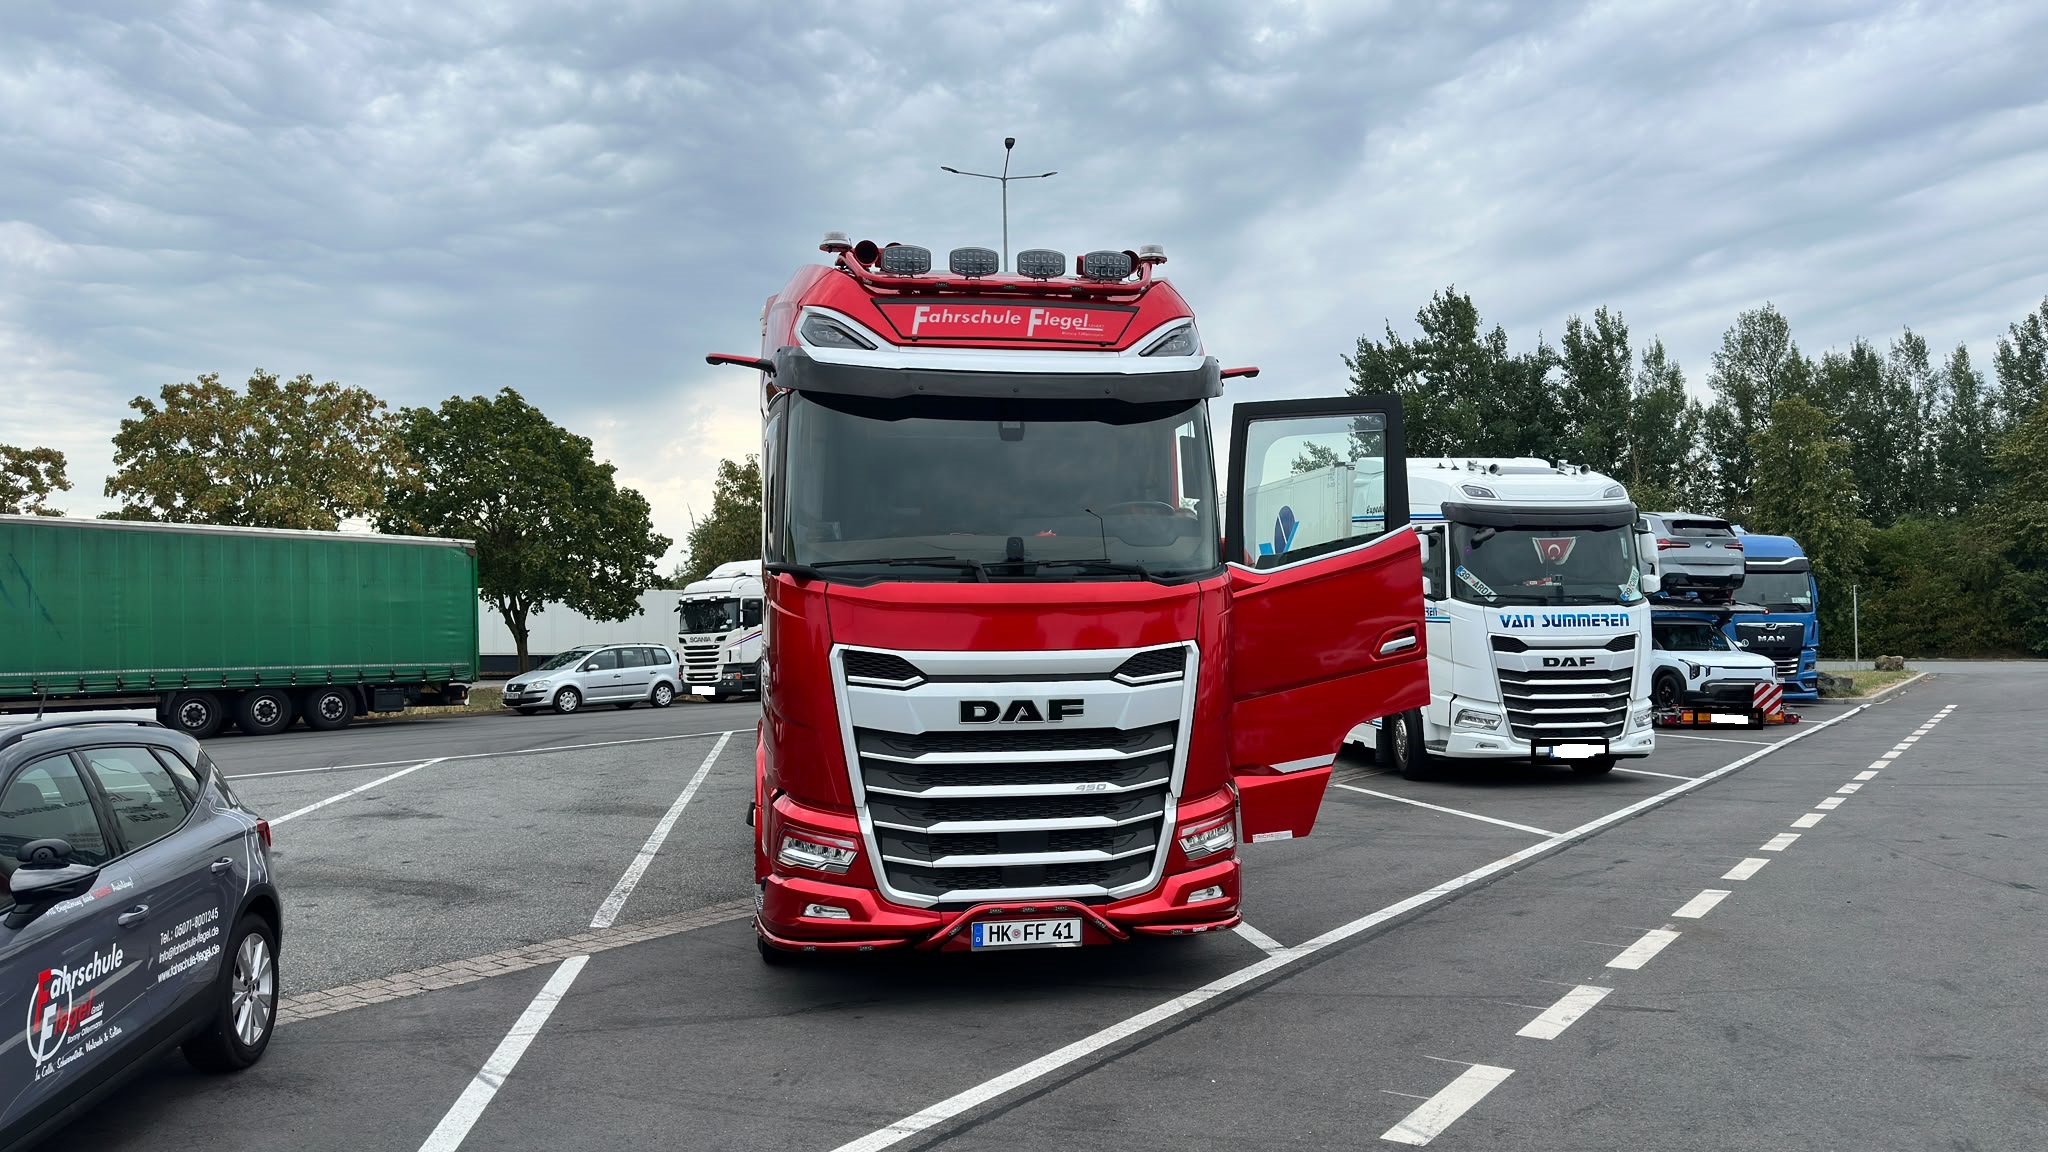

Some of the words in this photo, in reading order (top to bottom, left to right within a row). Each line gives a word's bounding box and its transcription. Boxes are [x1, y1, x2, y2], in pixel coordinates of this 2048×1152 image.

[911, 306, 1021, 335] Fahrschule
[1027, 308, 1089, 337] Flegel
[1499, 614, 1535, 628] VAN
[1541, 613, 1630, 628] SUMMEREN
[1542, 656, 1595, 667] DAF
[958, 698, 1085, 725] DAF
[989, 924, 1012, 943] HK
[1023, 923, 1047, 941] FF
[1052, 922, 1074, 940] 41
[33, 943, 124, 1033] Fahrschule
[36, 988, 96, 1068] Flegel
